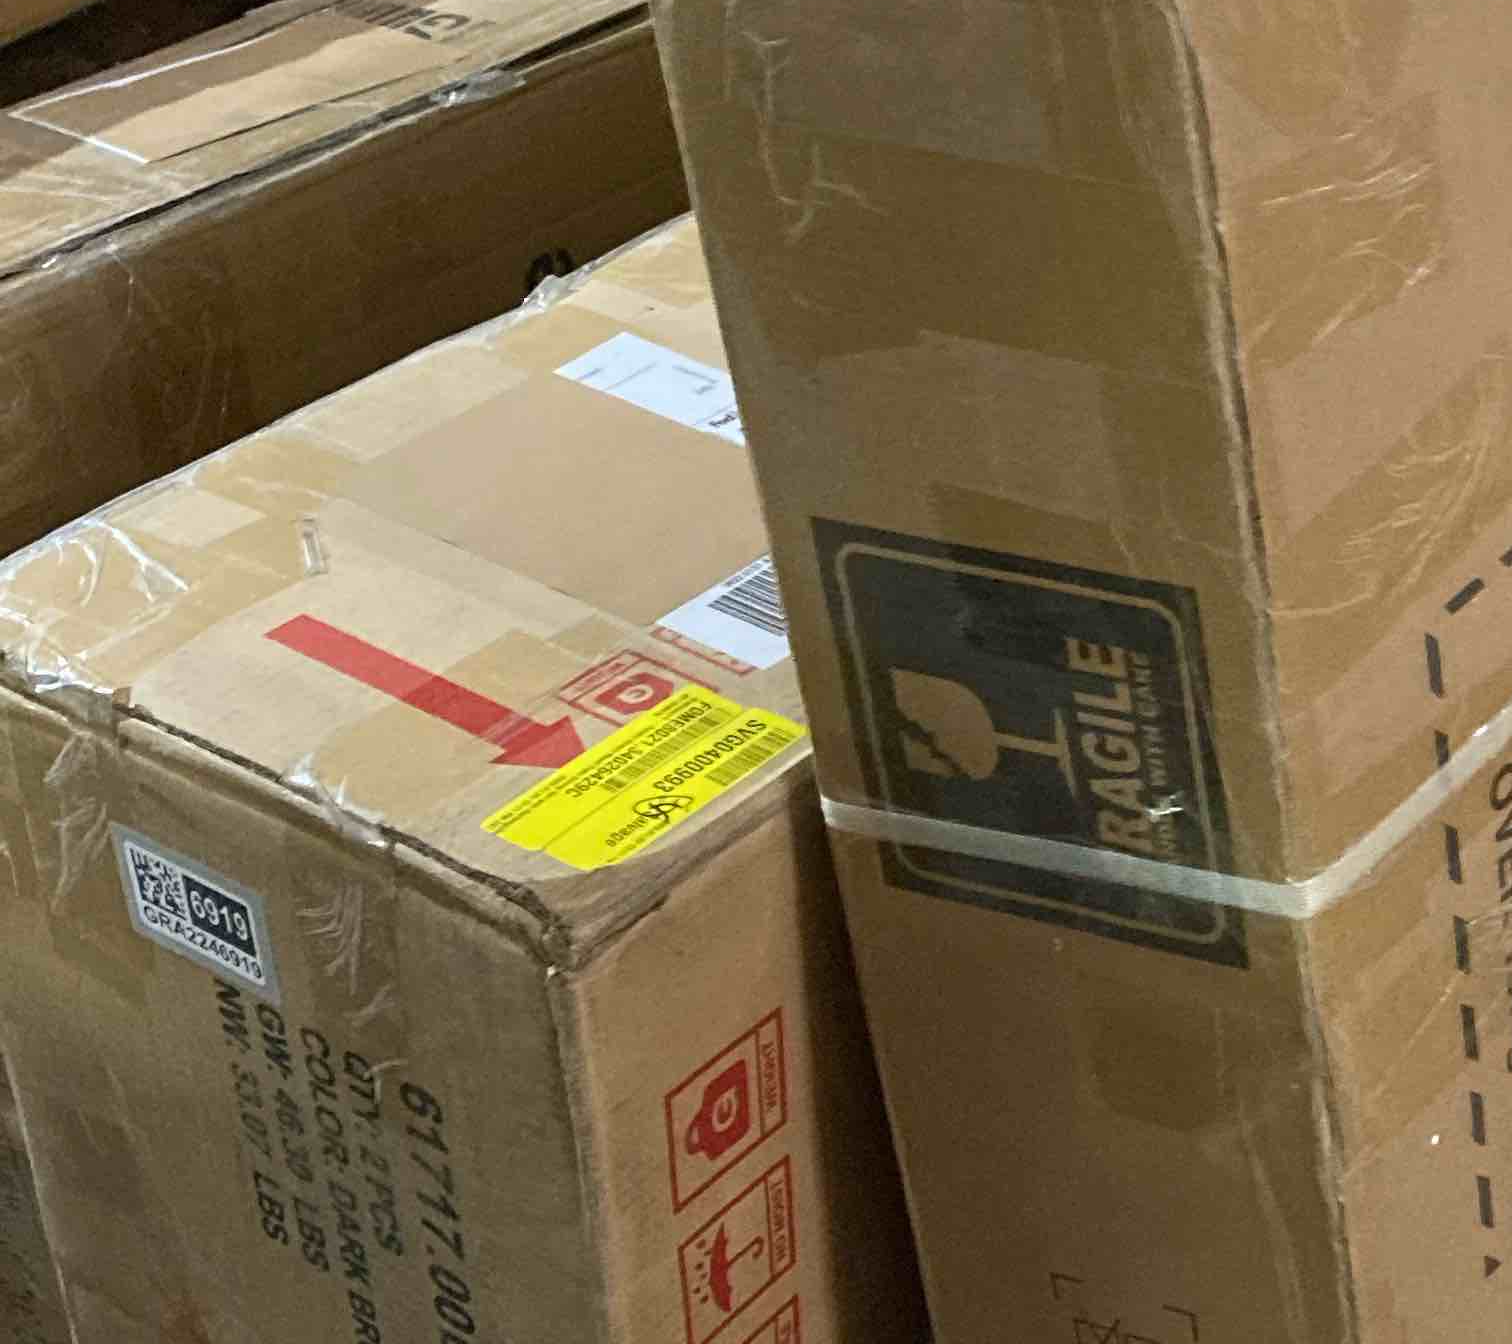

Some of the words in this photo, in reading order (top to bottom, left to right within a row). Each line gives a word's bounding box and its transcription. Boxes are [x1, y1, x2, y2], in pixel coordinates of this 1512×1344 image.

[652, 718, 768, 794] SVG0400993
[1064, 634, 1154, 858] RAGILE
[141, 906, 265, 981] GRA2246919
[187, 886, 250, 943] 6919
[253, 1169, 291, 1247] LBS
[293, 1196, 331, 1273] LBS
[328, 1178, 372, 1293] DARK
